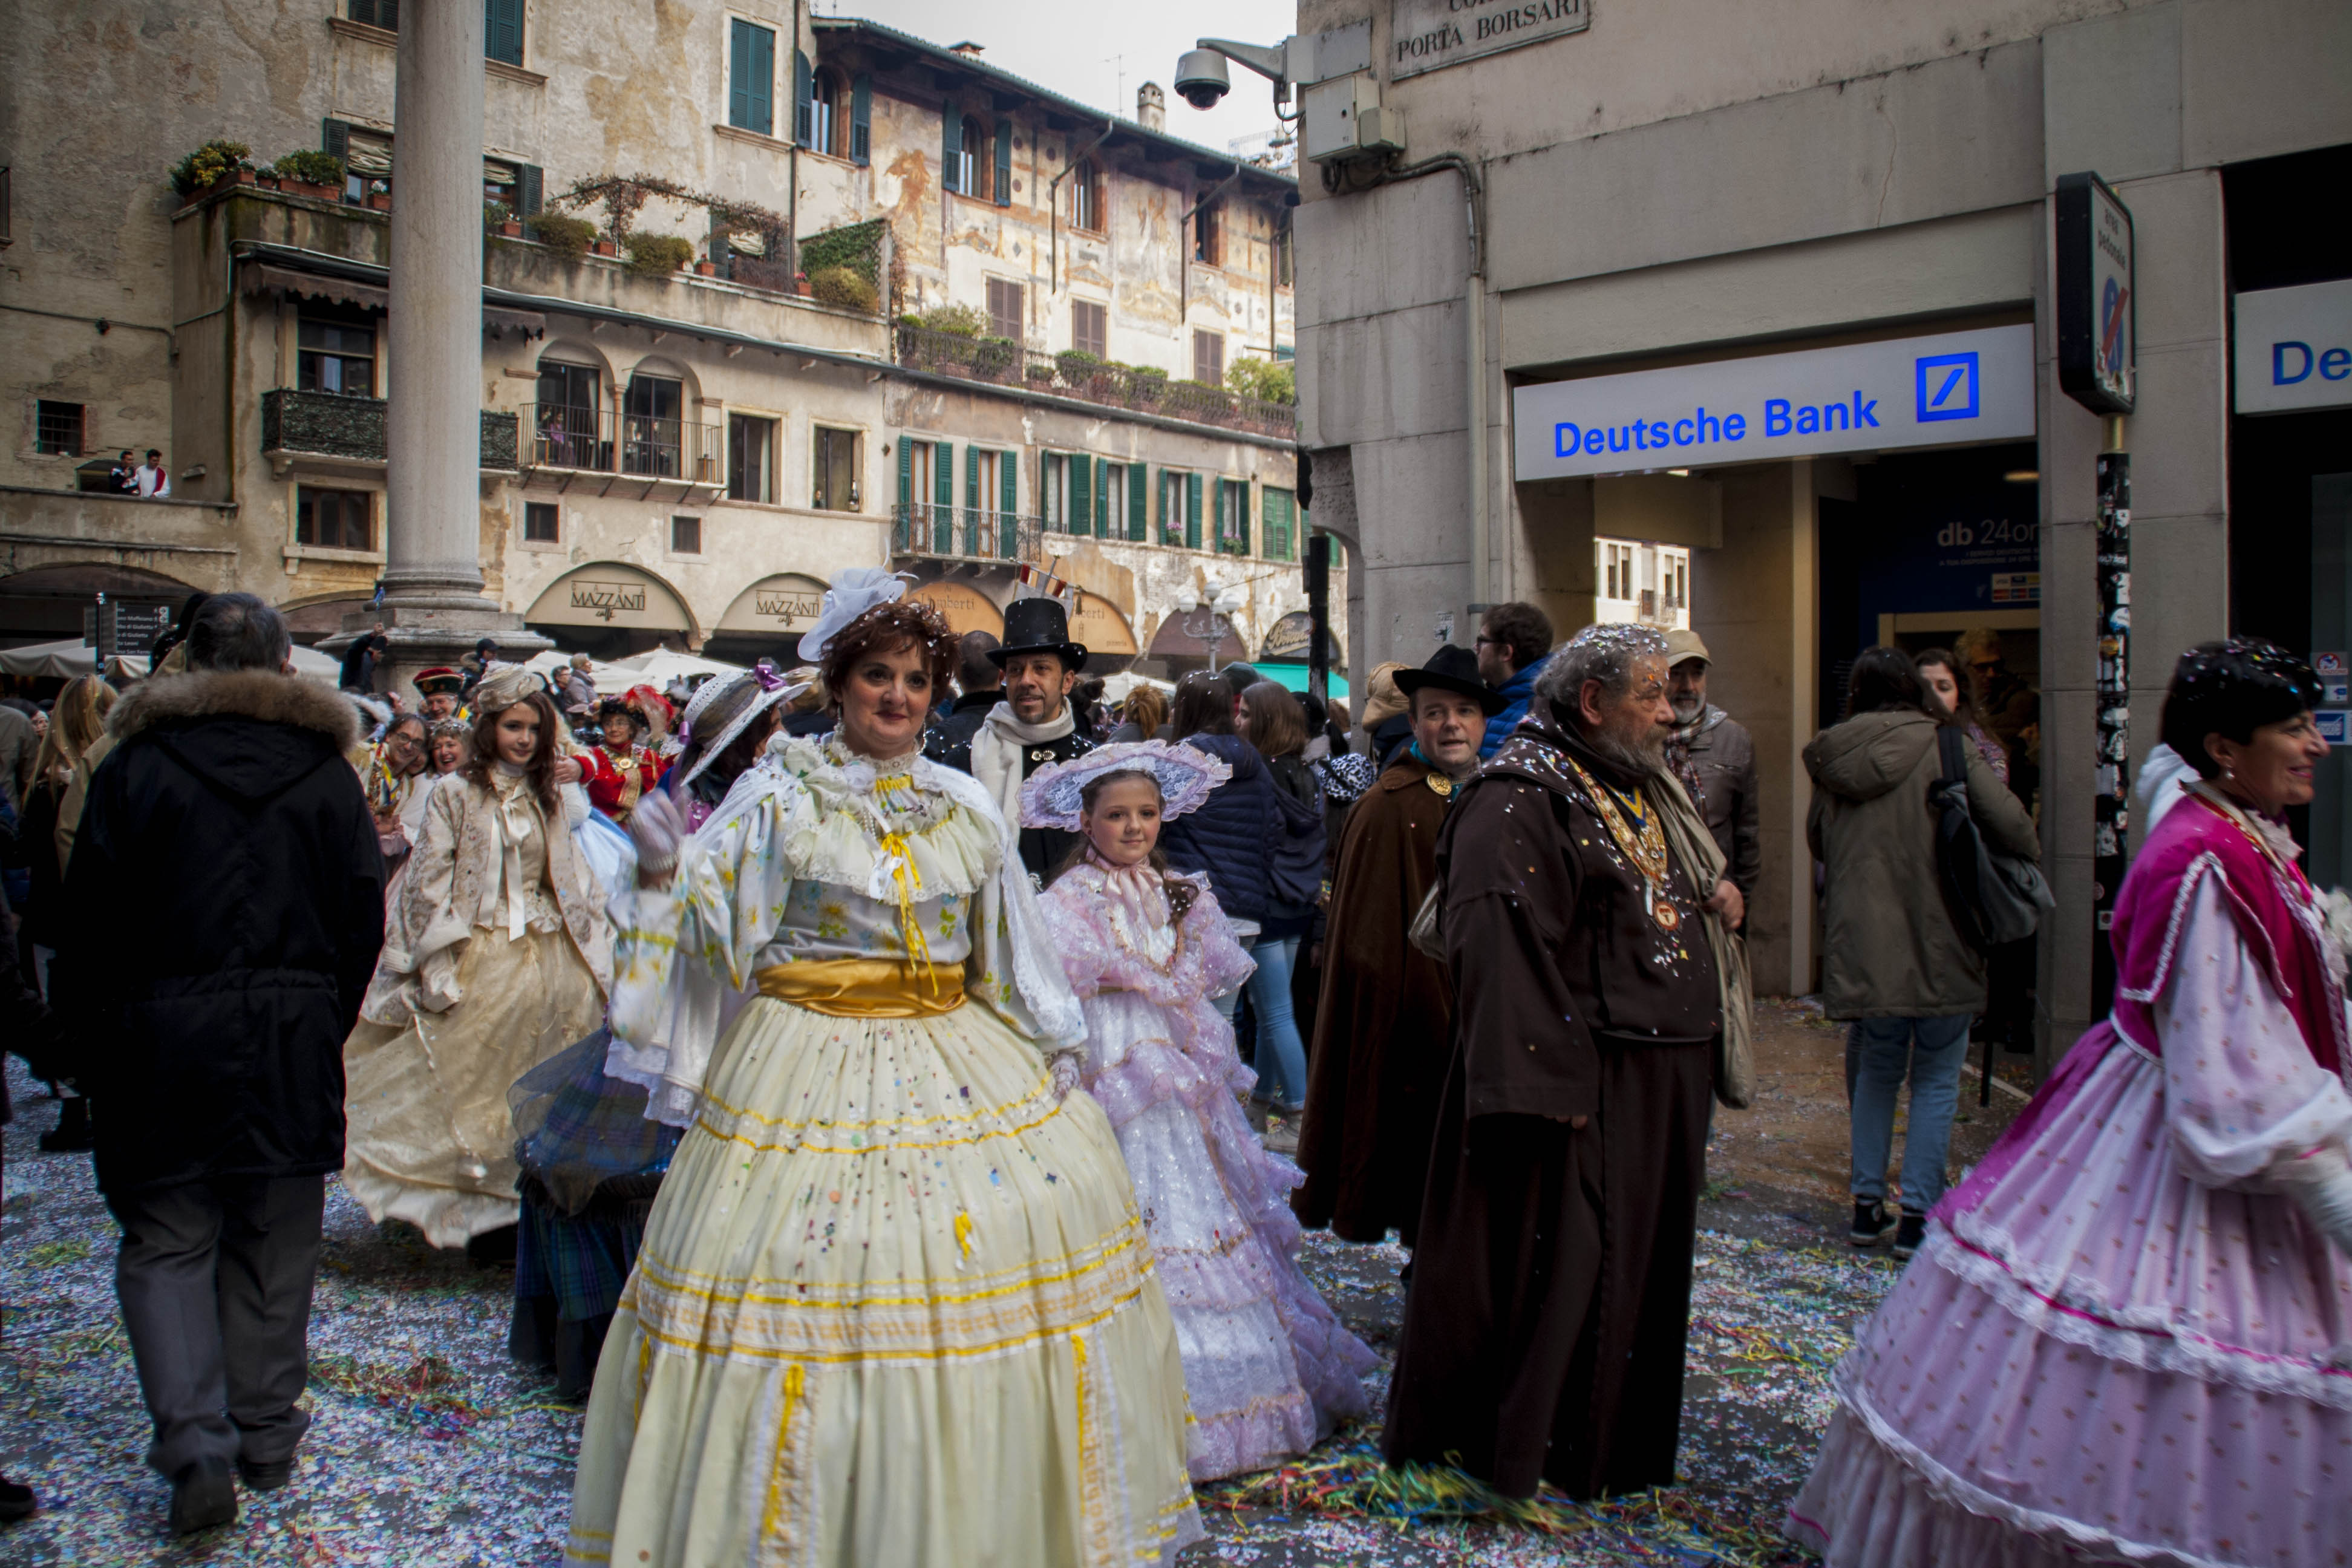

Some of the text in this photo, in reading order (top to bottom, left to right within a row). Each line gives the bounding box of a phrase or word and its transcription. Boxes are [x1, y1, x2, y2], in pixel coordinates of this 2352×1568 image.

[1397, 0, 1580, 62] PORTA BORSARI
[2272, 340, 2352, 387] De
[1555, 390, 1880, 458] Deutsche Bank
[1937, 521, 1975, 547] db
[570, 592, 645, 609] MAZZANTI
[756, 599, 820, 615] MAZZANTI
[920, 593, 975, 610] Lmberti
